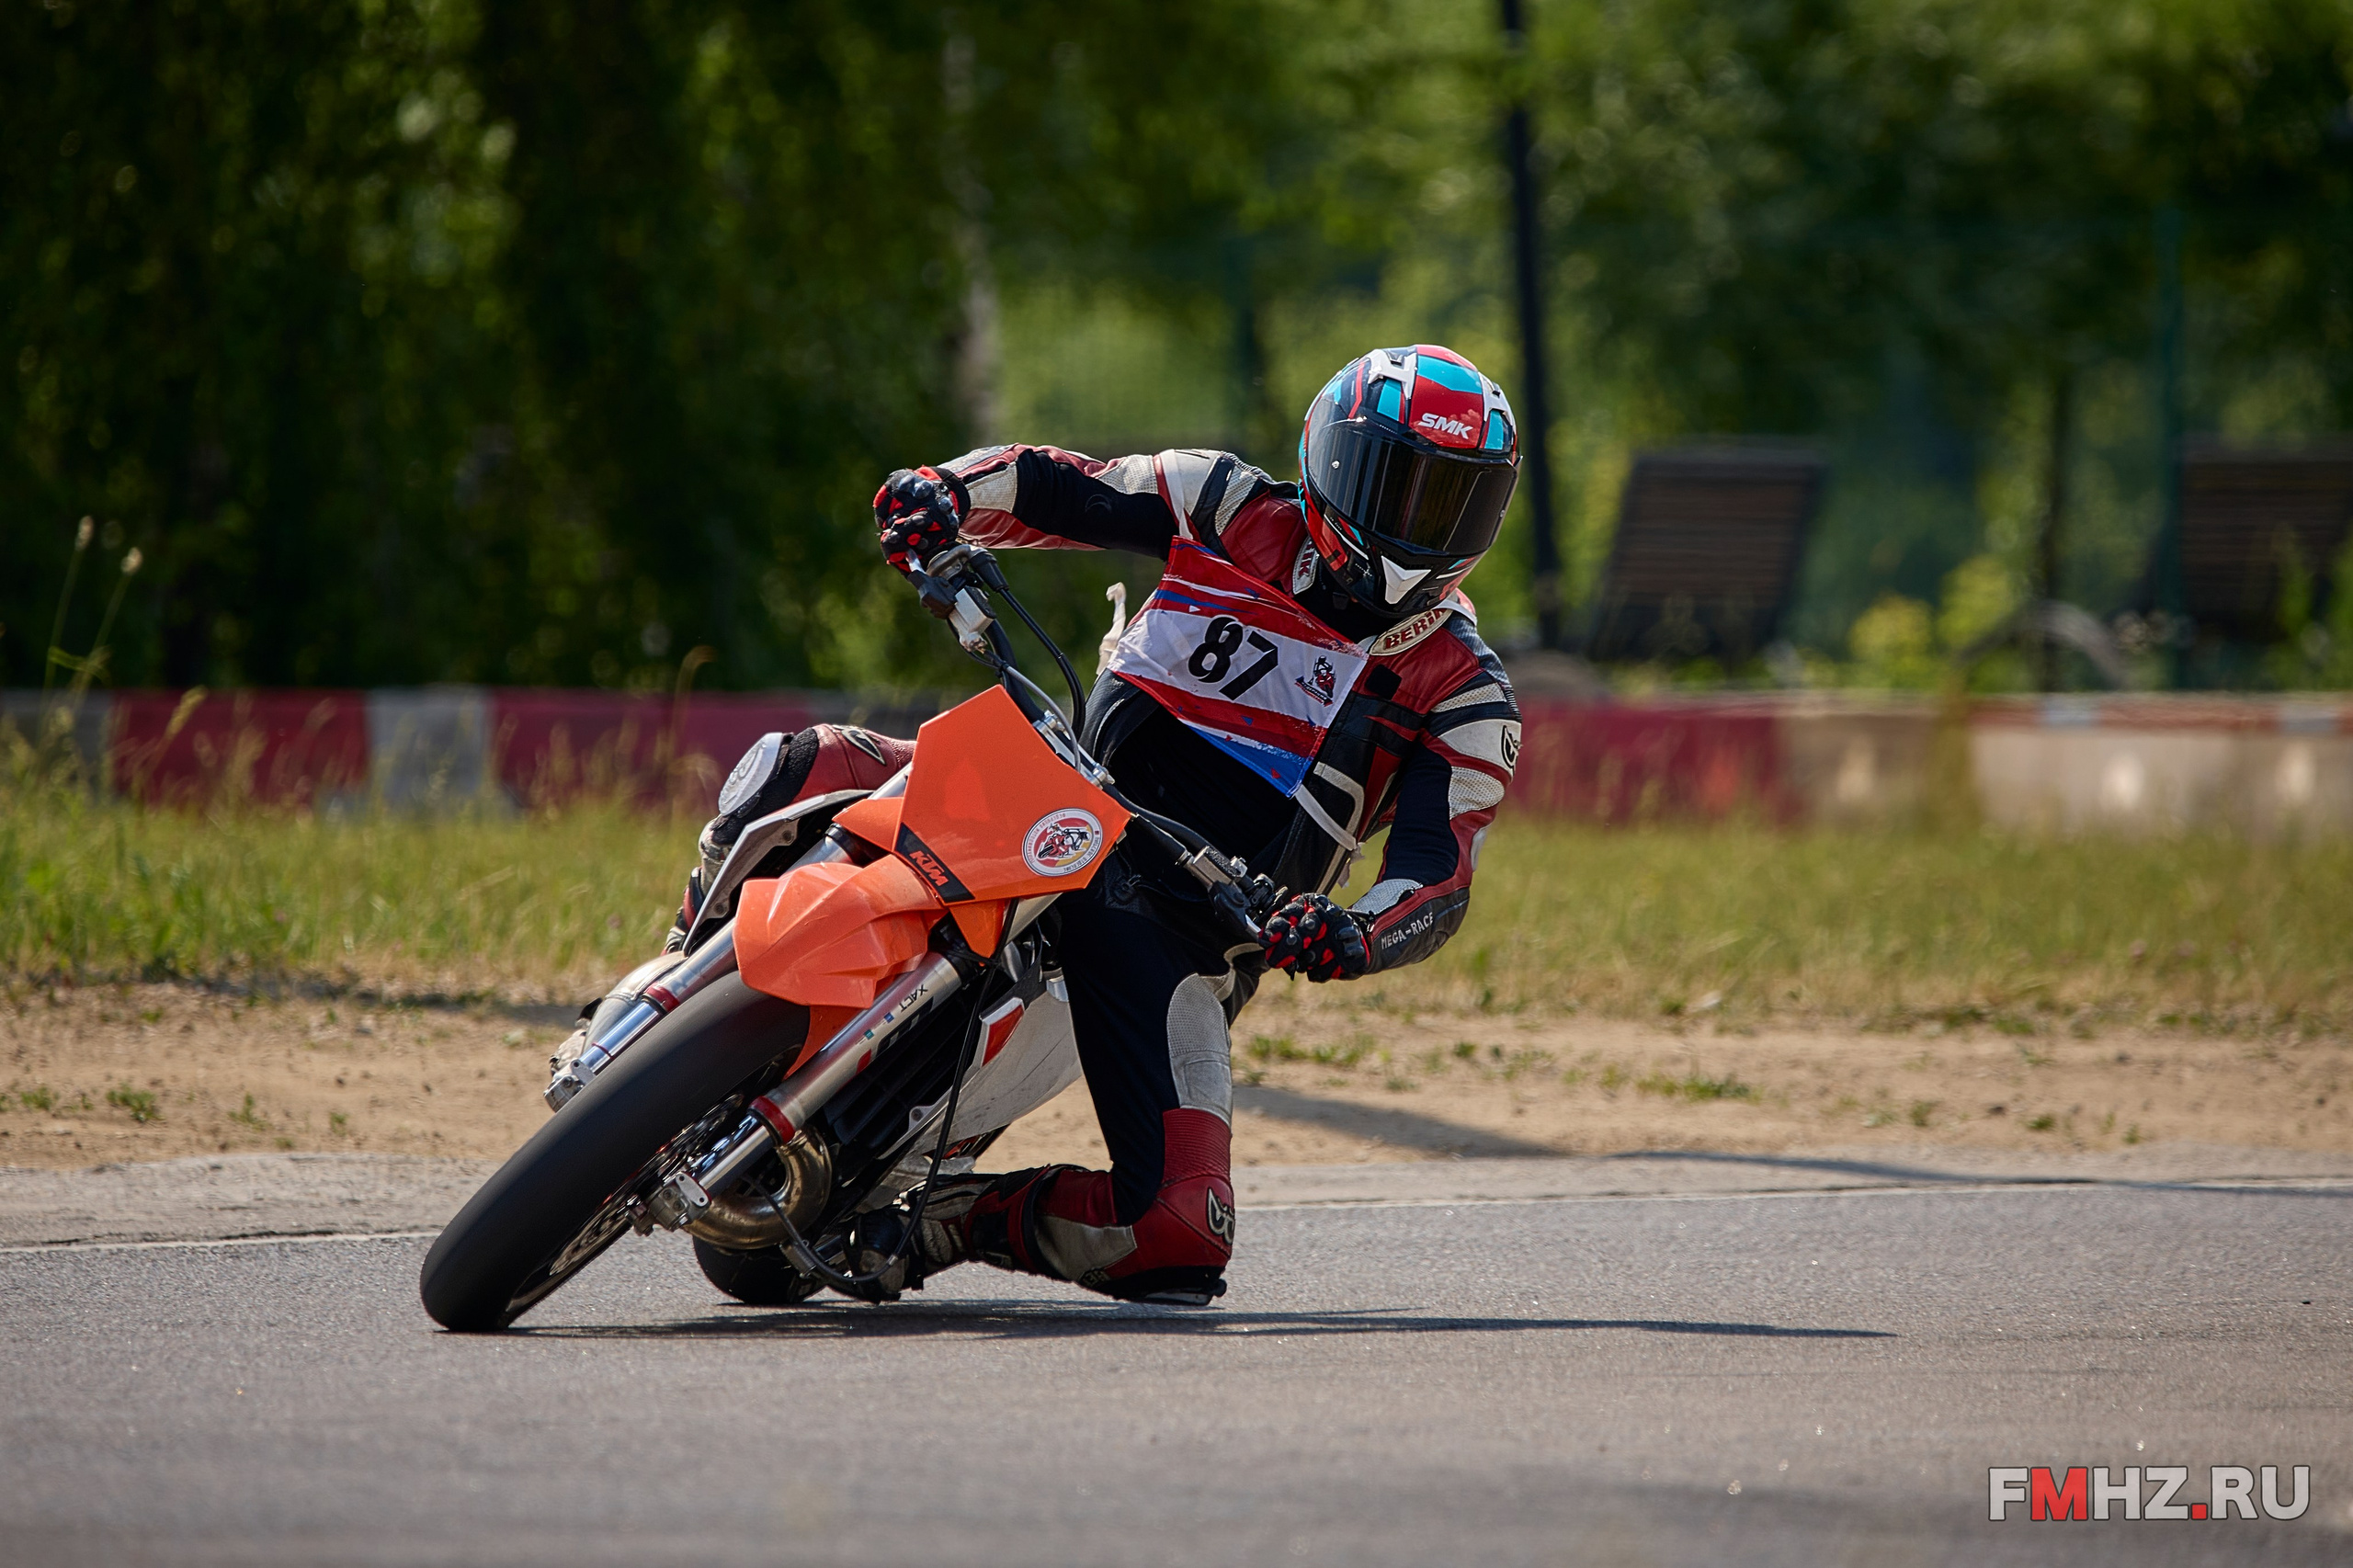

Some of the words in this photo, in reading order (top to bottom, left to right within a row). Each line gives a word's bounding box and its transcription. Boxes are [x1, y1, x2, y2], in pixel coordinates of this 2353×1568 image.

[1417, 413, 1473, 439] SMK
[1188, 617, 1279, 701] 87
[909, 850, 949, 887] KTM
[1381, 912, 1434, 950] MEGA-RACE
[899, 983, 928, 1013] XACT
